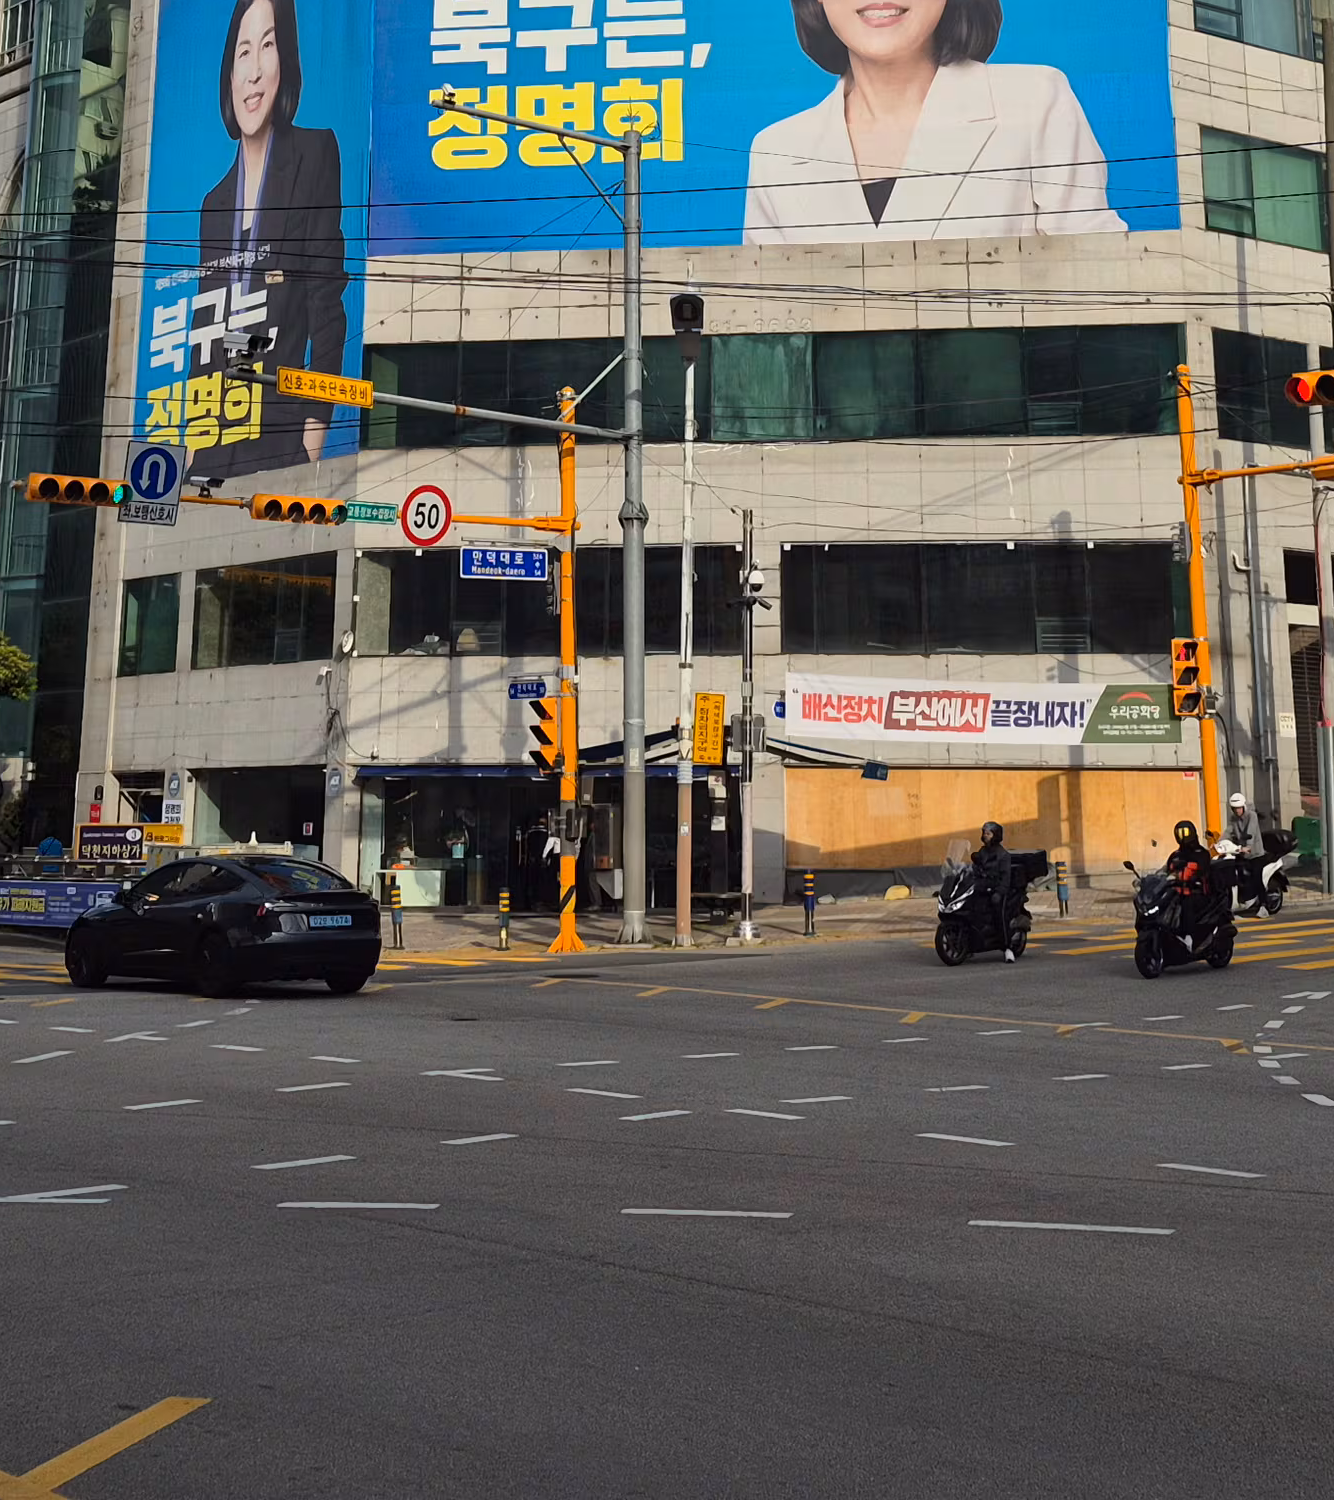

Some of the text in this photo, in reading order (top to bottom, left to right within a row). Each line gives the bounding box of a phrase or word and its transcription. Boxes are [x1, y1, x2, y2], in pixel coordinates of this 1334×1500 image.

[413, 502, 440, 530] 50
[472, 551, 525, 566] 만덕대로
[471, 565, 526, 576] Mandeok-daero
[891, 695, 985, 728] 부산에서
[1109, 705, 1161, 719] 우리공화당
[82, 843, 141, 859] 덕천지하상가
